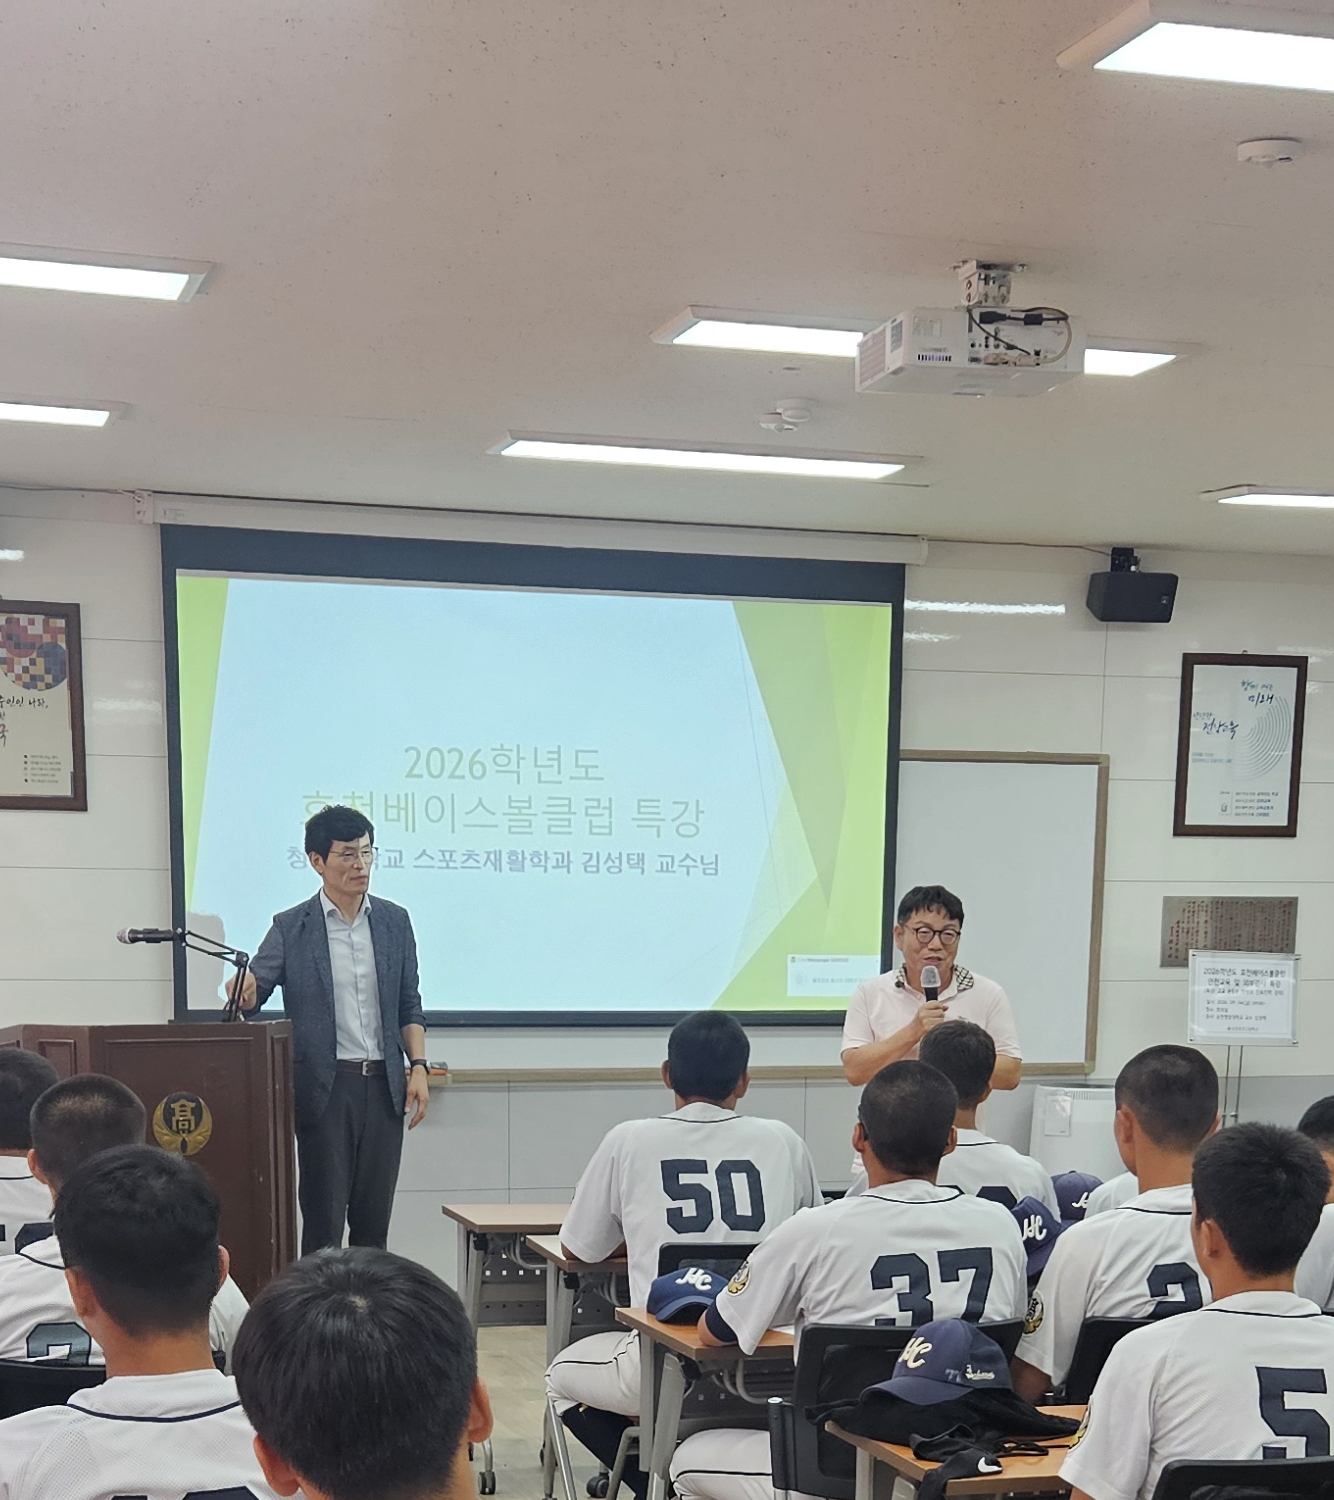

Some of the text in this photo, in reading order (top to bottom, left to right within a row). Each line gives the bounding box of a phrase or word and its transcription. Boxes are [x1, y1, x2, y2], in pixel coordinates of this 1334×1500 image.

[404, 743, 605, 785] 2026학년도
[631, 797, 706, 840] 특강
[413, 847, 573, 875] 스포츠재활학과
[581, 850, 646, 876] 김성택
[655, 851, 720, 877] 교수님
[661, 1159, 765, 1233] 50
[870, 1247, 993, 1326] 37
[1254, 1366, 1331, 1460] 5
